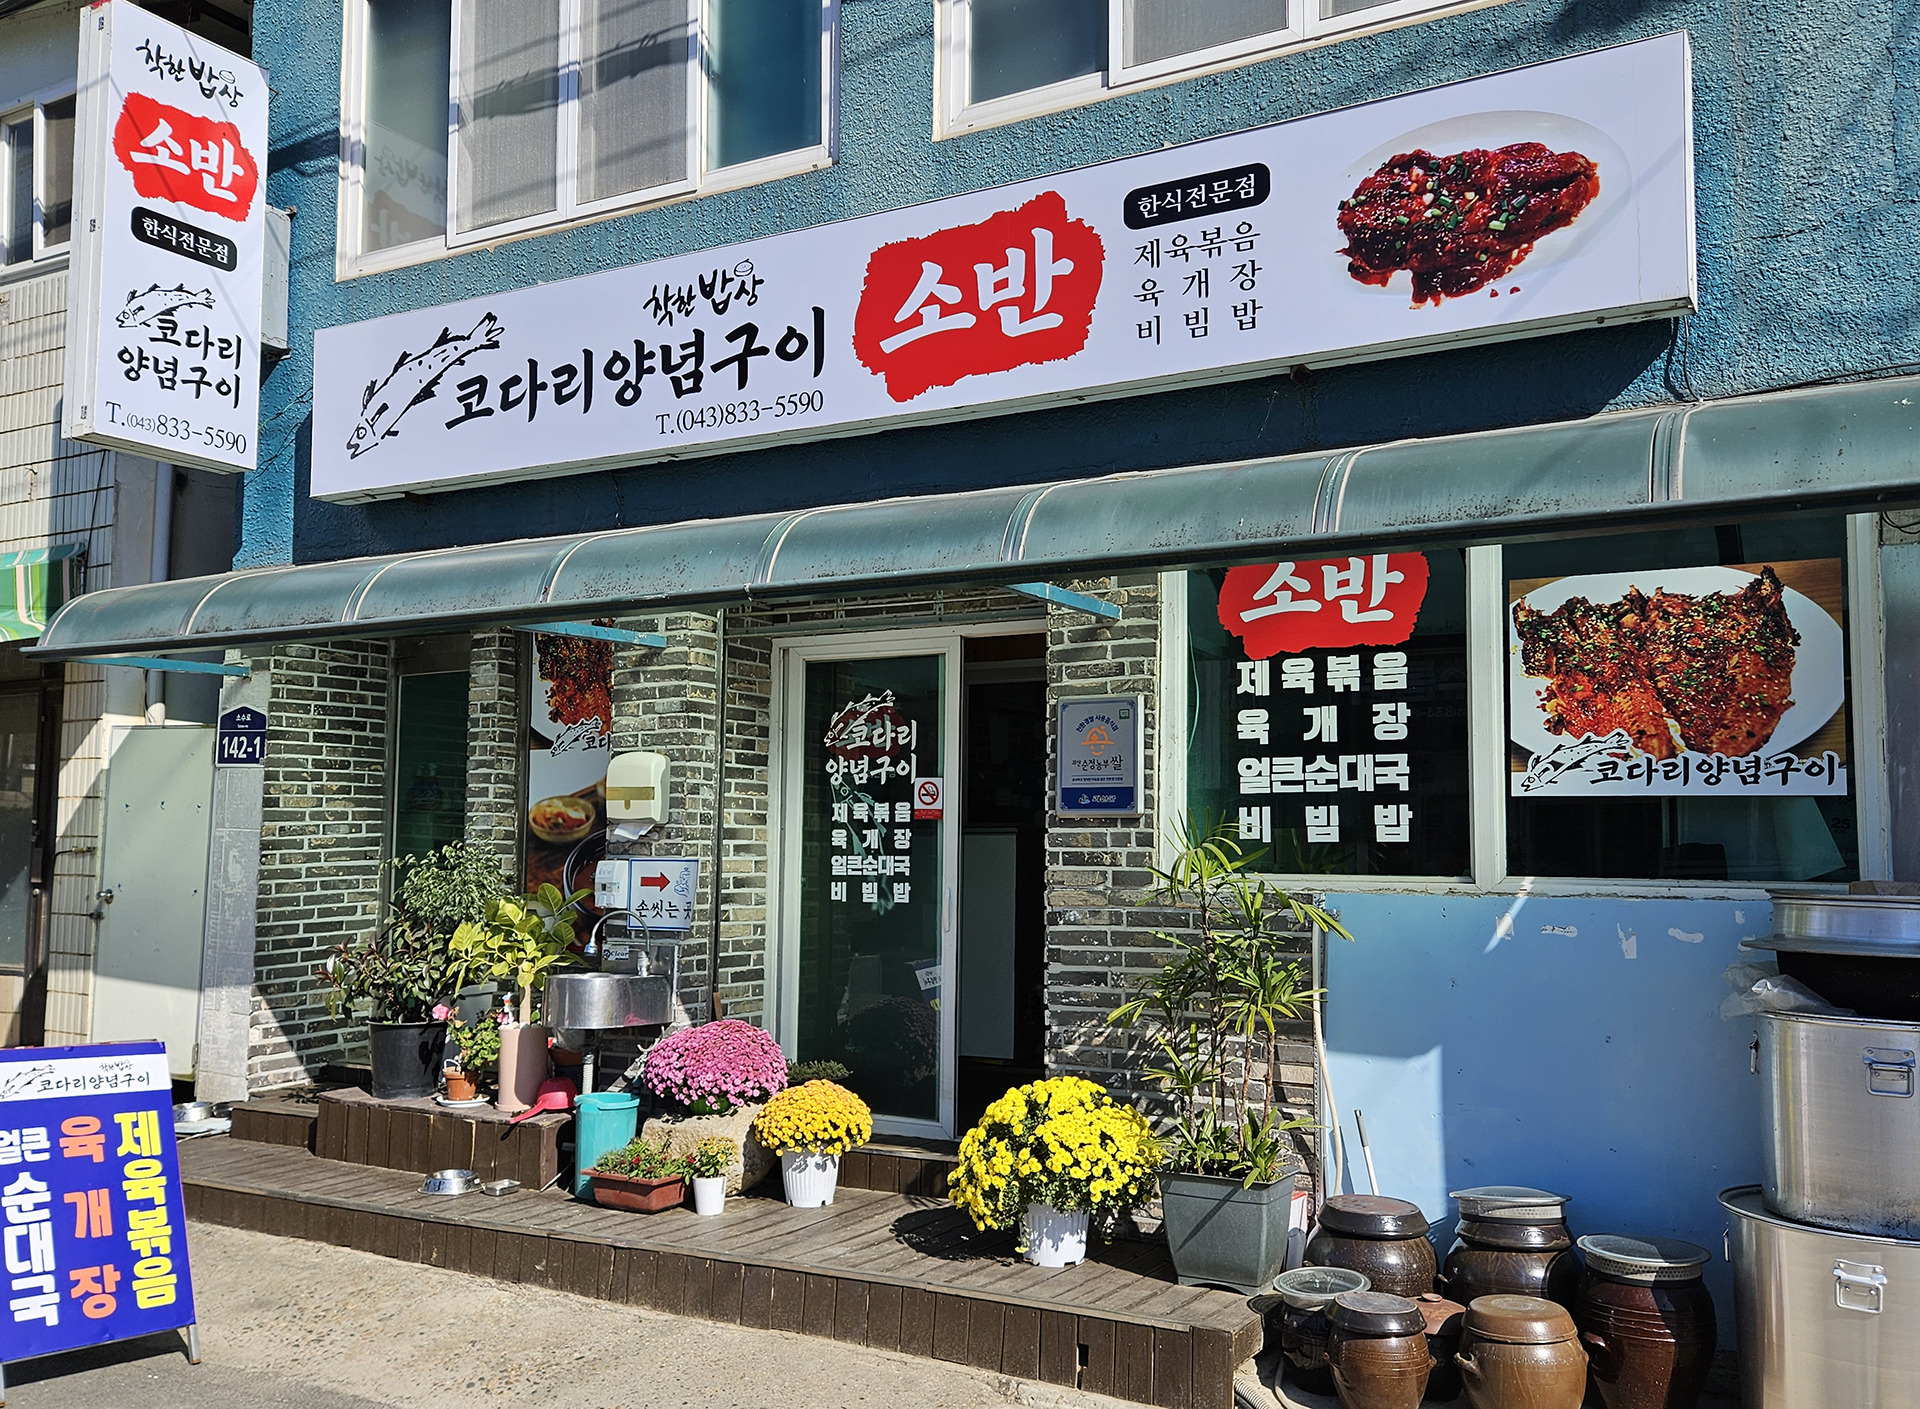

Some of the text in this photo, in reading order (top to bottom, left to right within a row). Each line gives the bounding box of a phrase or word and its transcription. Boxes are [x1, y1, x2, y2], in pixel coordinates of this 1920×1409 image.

[129, 118, 245, 202] 소반
[1137, 173, 1256, 219] 한식전문점
[142, 216, 229, 264] 한식전문점
[1133, 220, 1261, 269] 제육볶음
[879, 227, 1075, 355] 소반
[149, 318, 242, 370] 코다리
[117, 346, 241, 409] 양념구이
[444, 305, 825, 431] 코다리양념구이
[1239, 553, 1405, 624] 소반
[1236, 651, 1409, 697] 제육볶음
[222, 736, 261, 759] 142-1
[846, 719, 917, 751] 코다리
[825, 753, 917, 785] 양념구이
[1237, 753, 1410, 794] 얼큰순대국
[1589, 752, 1837, 787] 코다리양념구이
[831, 801, 912, 824] 제육볶음
[831, 855, 911, 876] 얼큰순대국
[635, 899, 680, 919] 손씻는
[37, 1071, 150, 1093] 코다리양념구이
[59, 1115, 122, 1319] 육개장
[113, 1110, 178, 1310] 제육볶음
